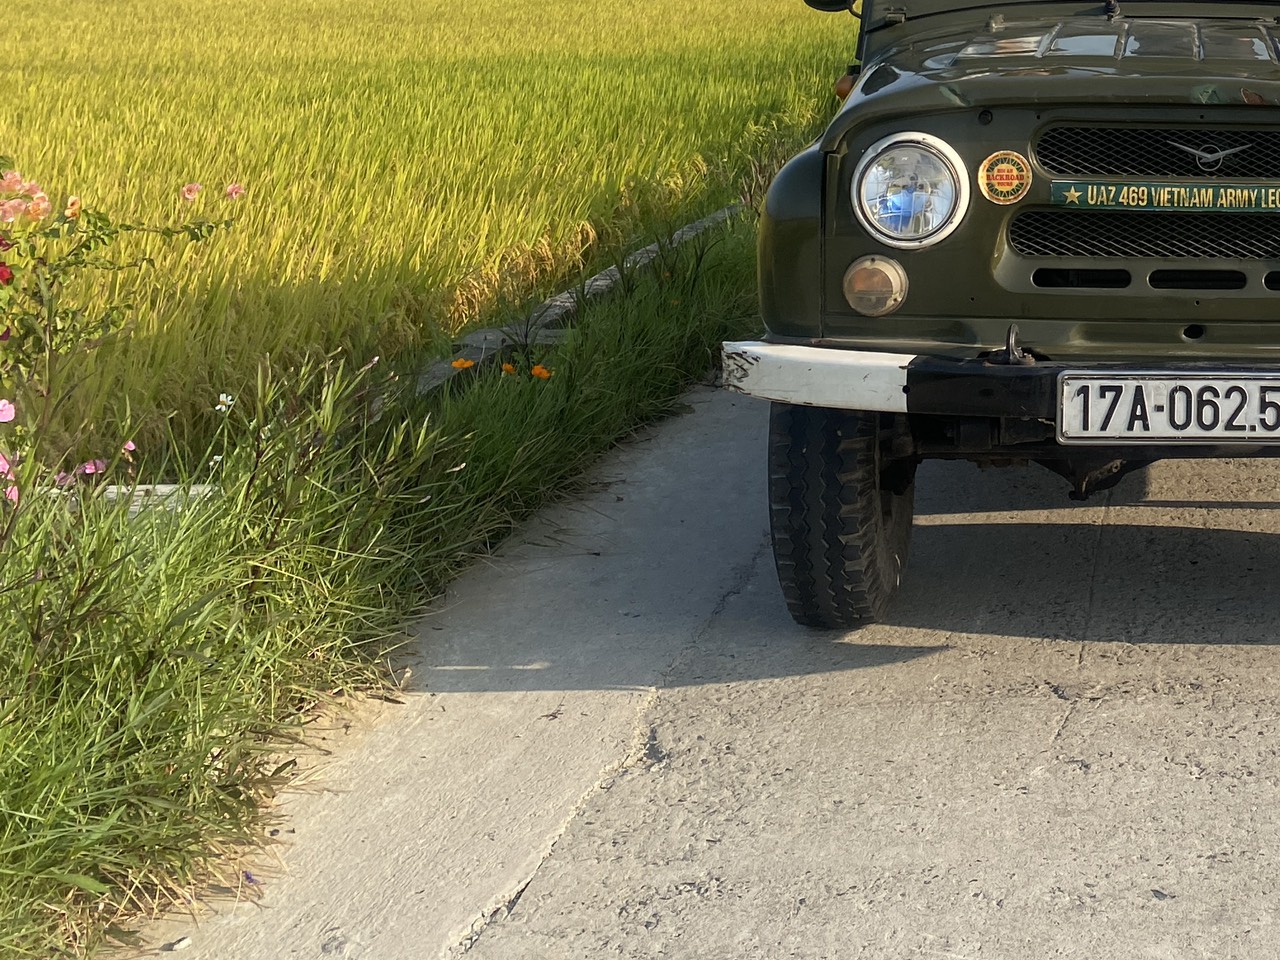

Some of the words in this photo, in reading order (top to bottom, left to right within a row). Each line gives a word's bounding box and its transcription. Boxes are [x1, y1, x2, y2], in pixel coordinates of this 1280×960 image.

[1087, 185, 1116, 205] UAZ
[1119, 186, 1147, 206] 469
[1151, 187, 1213, 207] VIETNAM
[1217, 188, 1257, 208] ARMY
